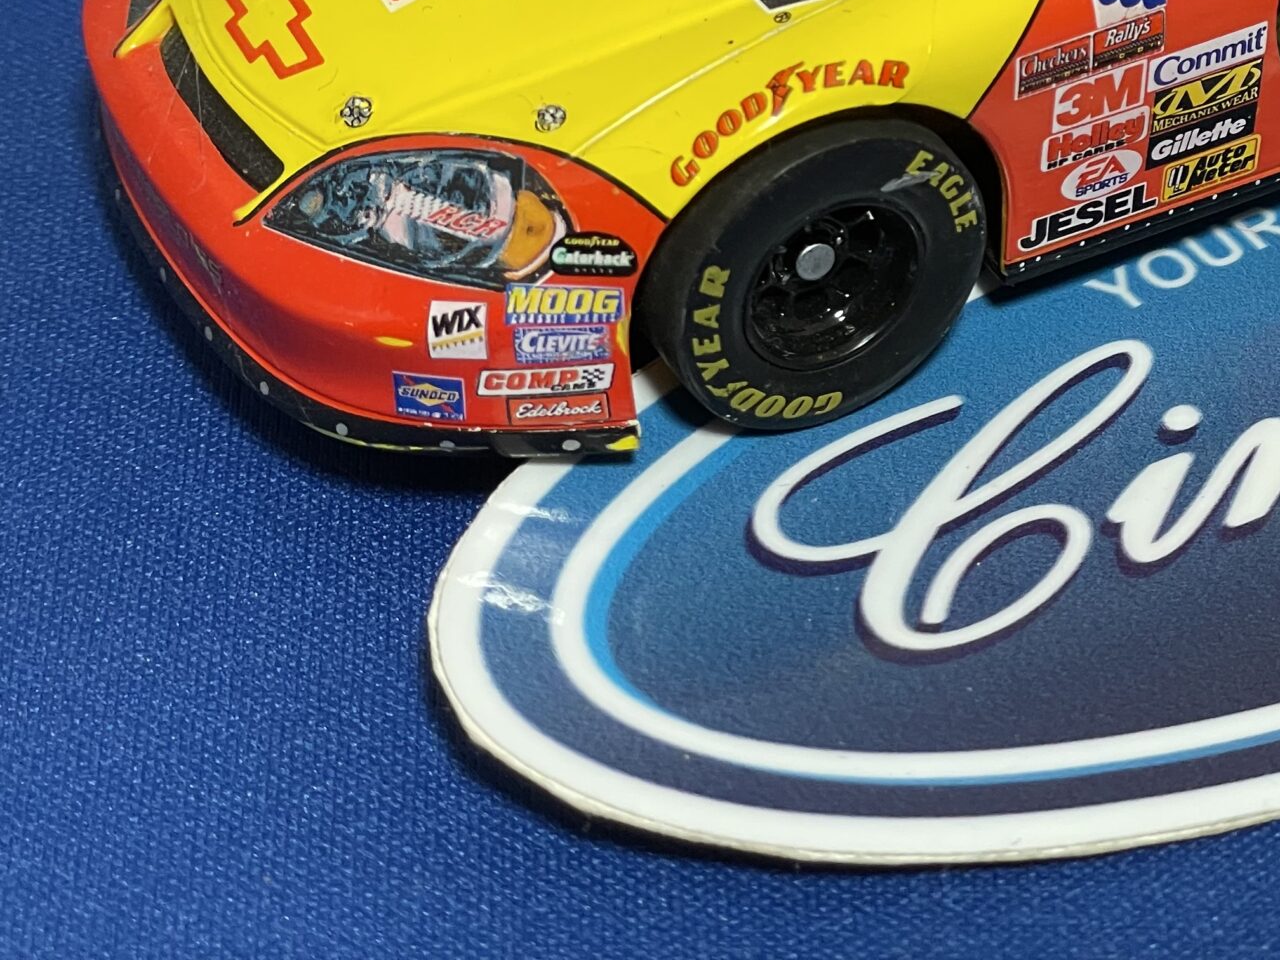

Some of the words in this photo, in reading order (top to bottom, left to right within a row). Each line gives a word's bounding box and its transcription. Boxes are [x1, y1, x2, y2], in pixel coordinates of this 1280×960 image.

[1105, 18, 1151, 48] Rally's
[1021, 46, 1087, 78] Checkers
[1154, 26, 1266, 86] Commit
[1056, 63, 1145, 127] 3M
[1153, 104, 1219, 133] MECHANIX
[1221, 86, 1258, 110] WEAR
[670, 59, 910, 187] GOODYEAR
[1047, 112, 1145, 161] Holley
[1151, 118, 1246, 161] Gillette
[1076, 154, 1126, 187] EA
[1197, 144, 1248, 169] Auto
[905, 150, 978, 233] EAGLE
[1076, 173, 1130, 197] SPORTS
[1020, 184, 1157, 249] JESEL
[510, 287, 619, 315] MOOG
[432, 305, 482, 338] WIX
[521, 332, 602, 355] CLEVITE
[692, 265, 844, 420] GOODYEAR
[399, 384, 460, 403] SUNOCO
[483, 368, 580, 391] COMP
[516, 401, 602, 421] Edelbrock
